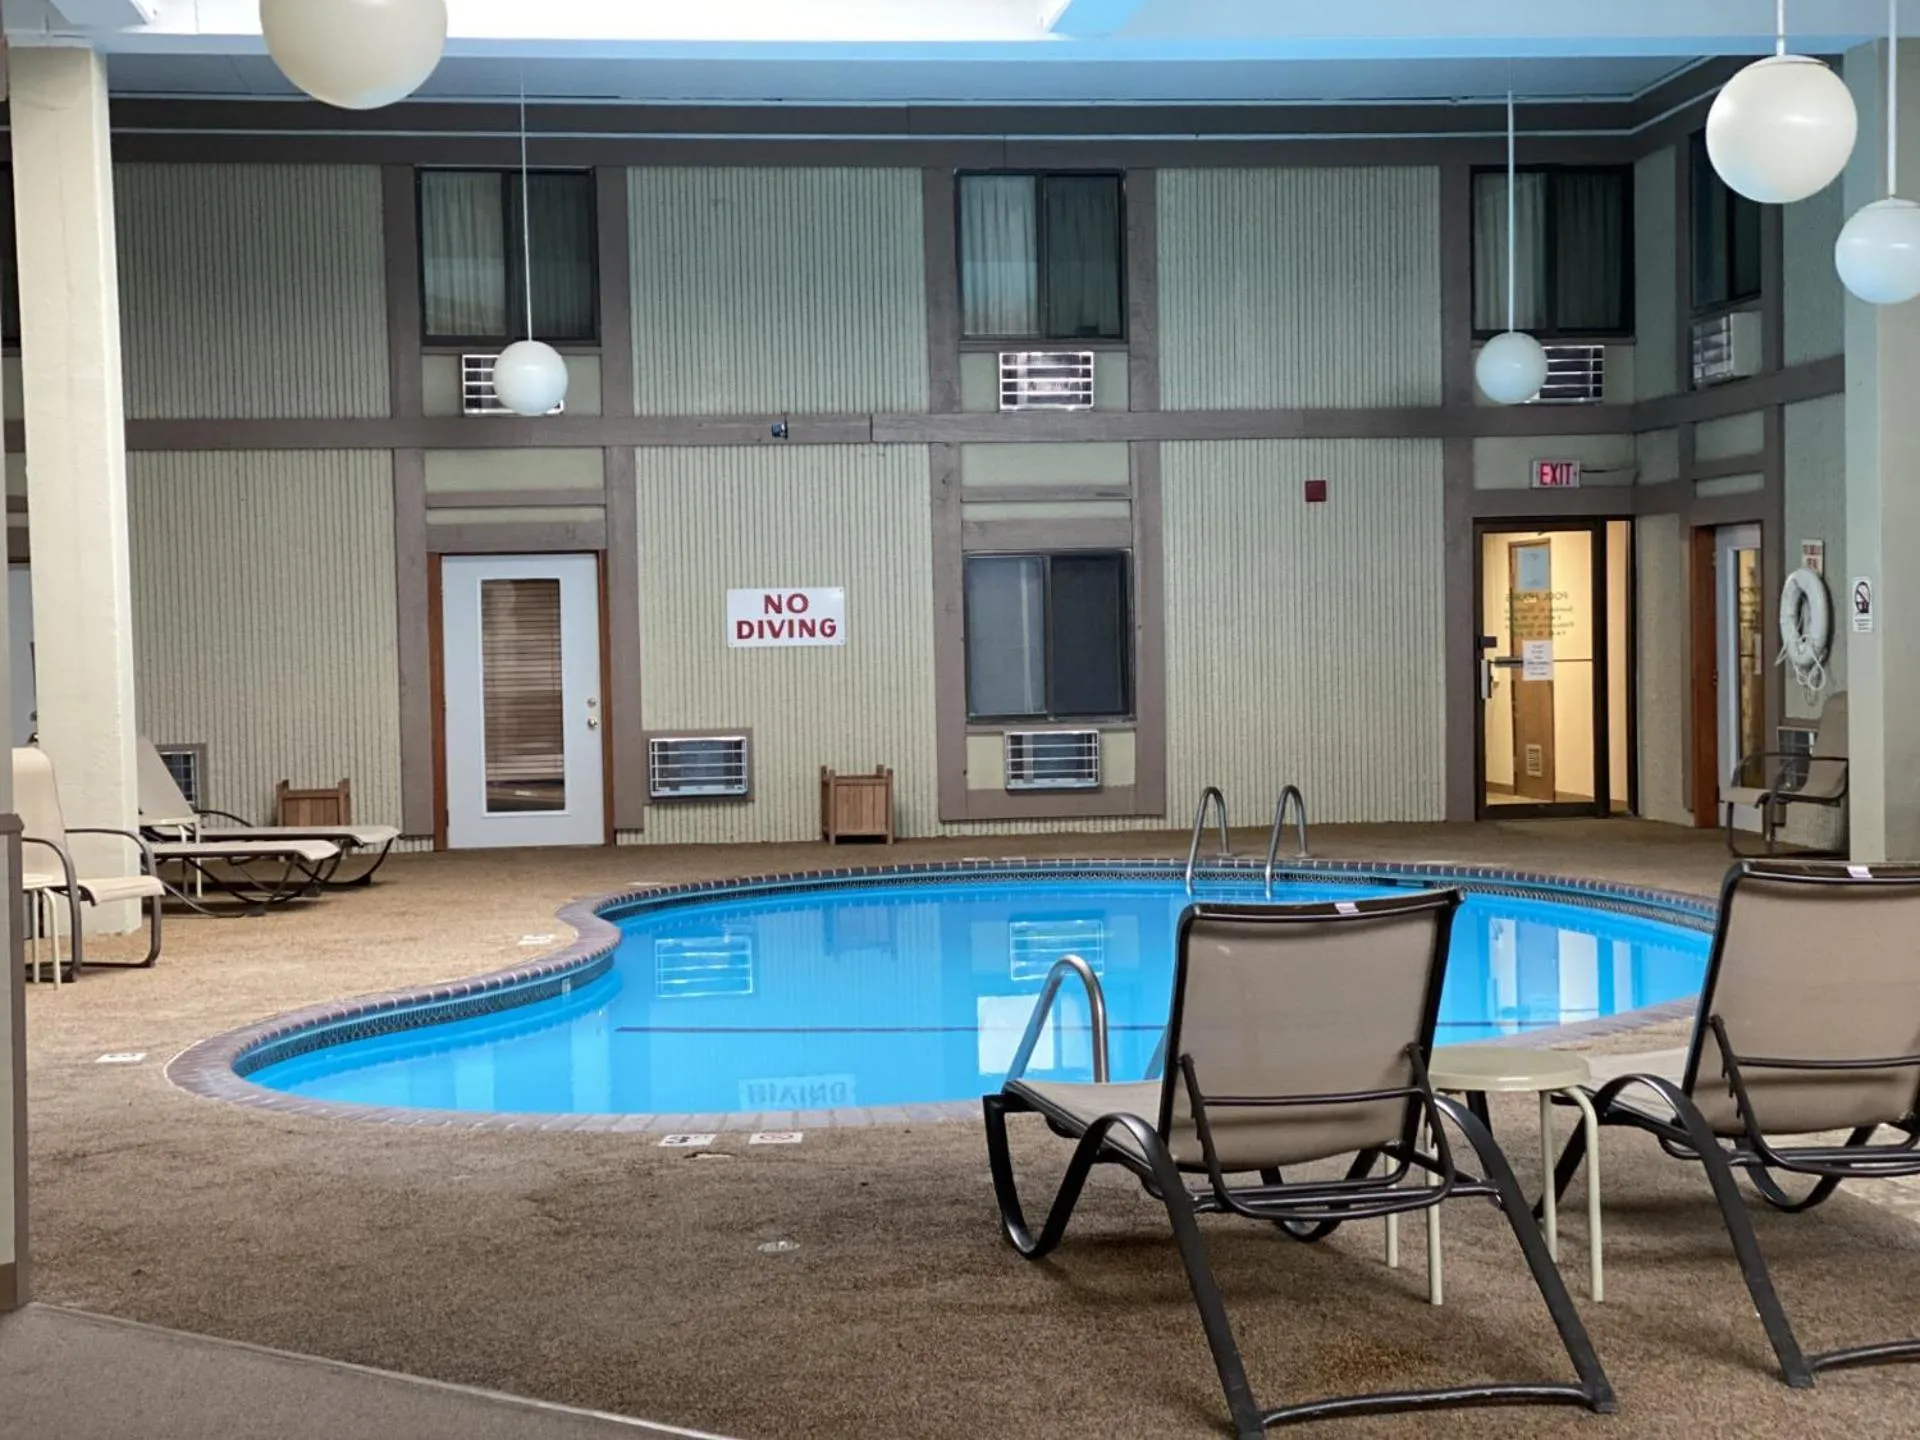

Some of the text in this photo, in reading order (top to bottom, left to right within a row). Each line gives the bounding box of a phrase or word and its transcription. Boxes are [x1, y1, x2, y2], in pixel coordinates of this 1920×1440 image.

[1540, 462, 1573, 486] EXIT
[764, 593, 809, 614] NO
[736, 618, 837, 640] DIVING
